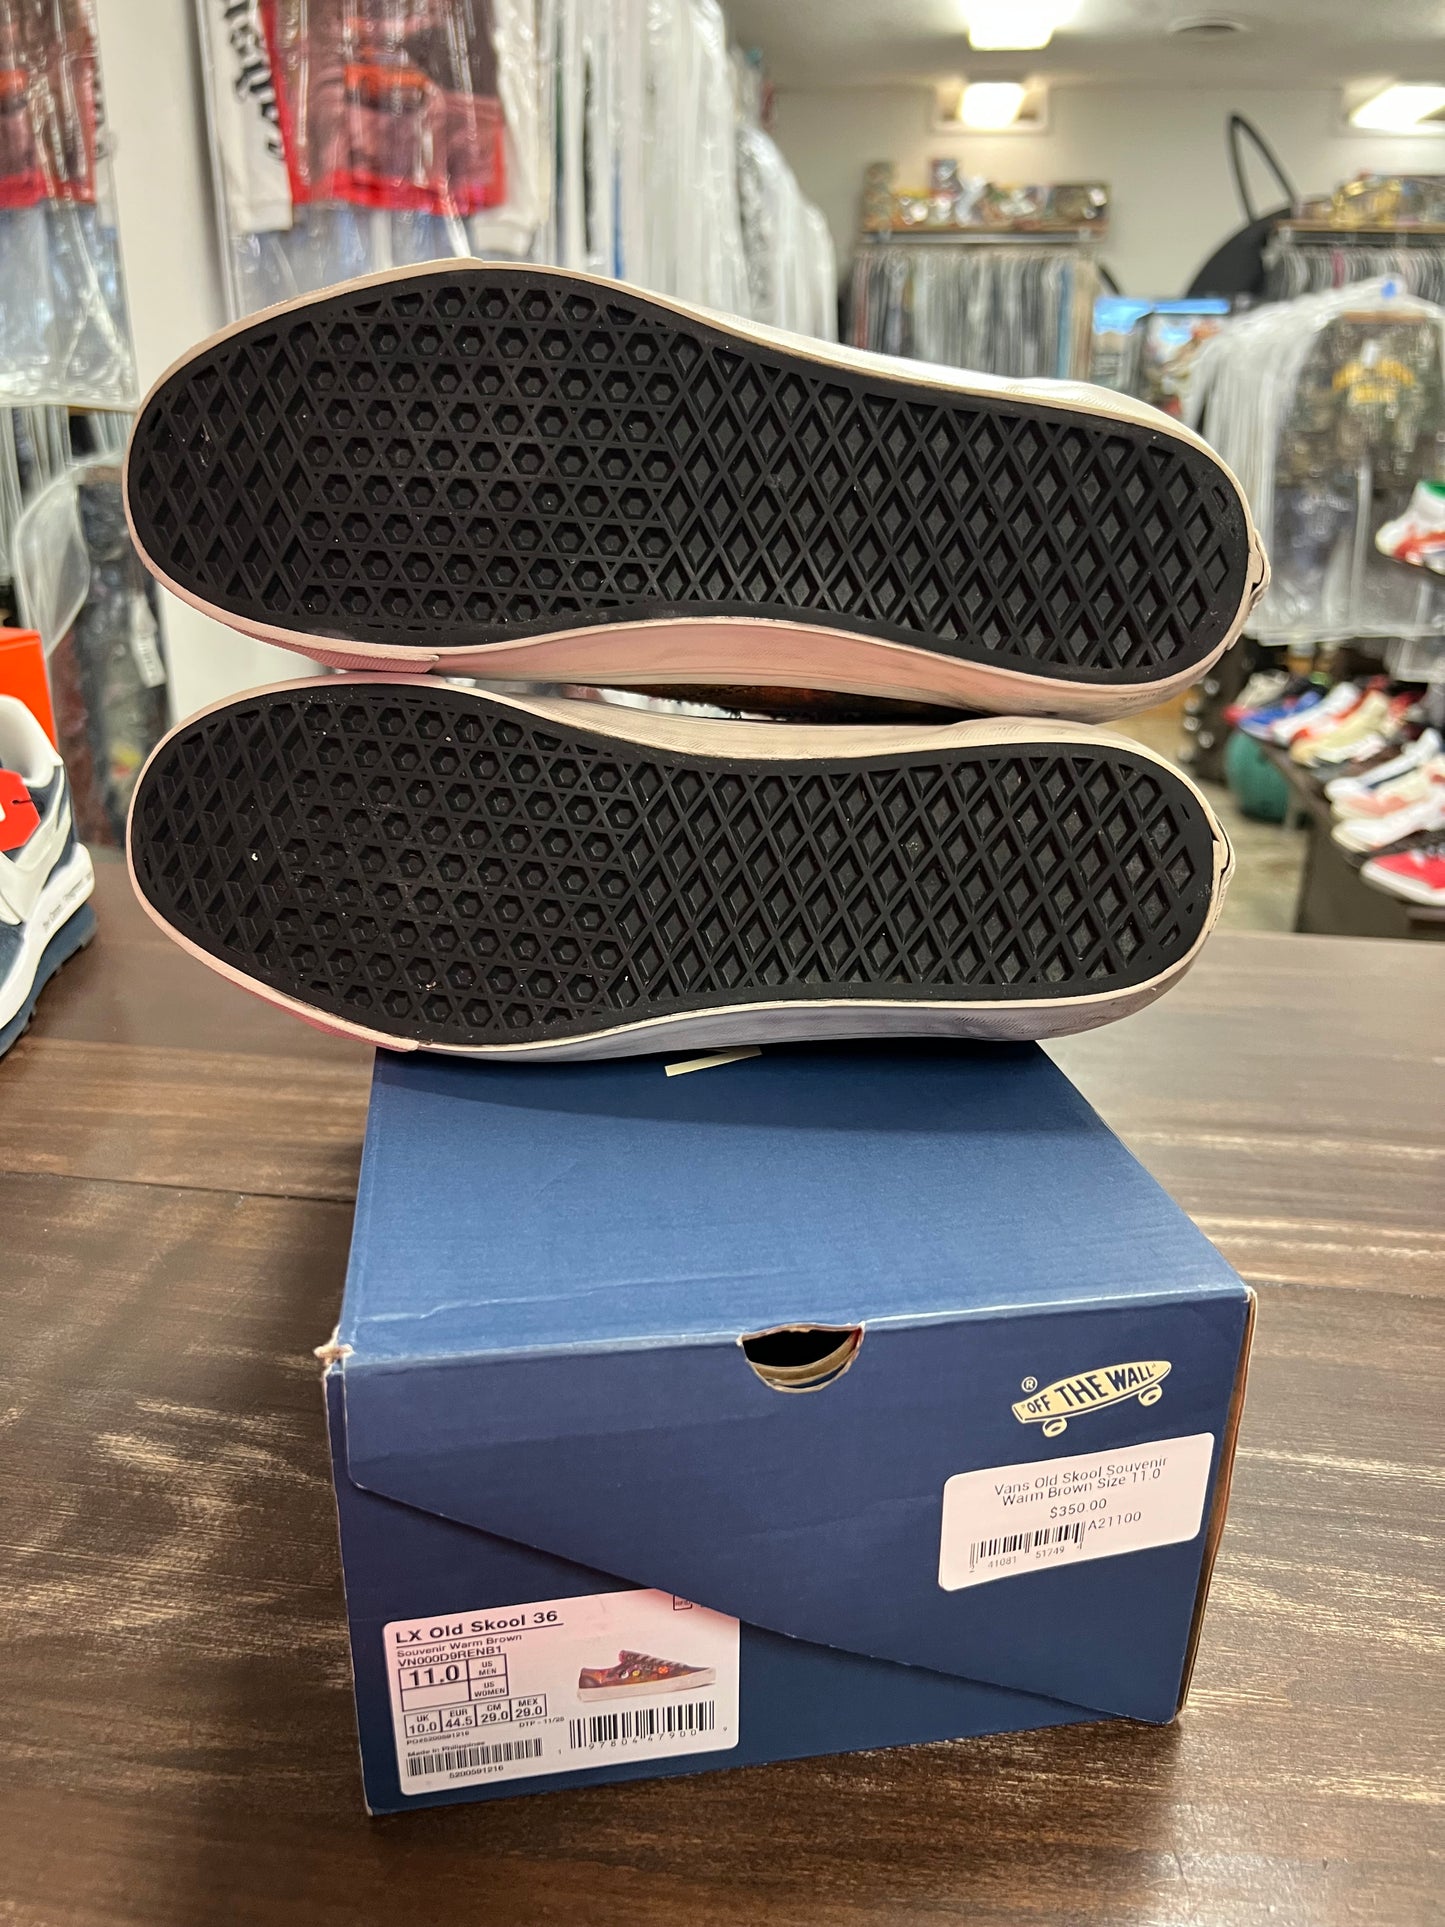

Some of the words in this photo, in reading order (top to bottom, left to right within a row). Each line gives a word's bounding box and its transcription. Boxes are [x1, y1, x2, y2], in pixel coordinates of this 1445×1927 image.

[1054, 1374, 1109, 1407] THE
[994, 1482, 1030, 1496] Vans
[1034, 1474, 1058, 1488] Old
[1062, 1466, 1102, 1484] Skool
[1107, 1455, 1168, 1475] Souvenir
[1002, 1491, 1044, 1506] Warm
[1048, 1483, 1093, 1499] Brown
[1097, 1475, 1126, 1489] Size
[1132, 1468, 1161, 1483] 11.0
[1049, 1498, 1108, 1519] $350.00
[1087, 1511, 1142, 1531] A21100
[1035, 1546, 1066, 1559] 51749
[395, 1629, 423, 1644] LX
[429, 1623, 464, 1638] Old
[471, 1614, 526, 1633] Skool
[533, 1610, 558, 1624] 36
[397, 1644, 446, 1657] Souvenir
[449, 1639, 483, 1651] Warm
[486, 1634, 522, 1646] Brown
[478, 1667, 497, 1676] MEN
[481, 1660, 493, 1668] US
[409, 1664, 460, 1686] 11.0
[483, 1680, 495, 1688] US
[474, 1687, 506, 1698] WOMEN
[409, 1721, 438, 1734] 10.0
[445, 1715, 473, 1729] 44.5
[480, 1710, 509, 1724] 29.0
[515, 1705, 543, 1719] 29.0
[416, 1714, 430, 1722] UK
[449, 1708, 468, 1717] EUR
[486, 1704, 502, 1712] CM
[518, 1697, 538, 1708] MEX
[407, 1747, 430, 1757] Made
